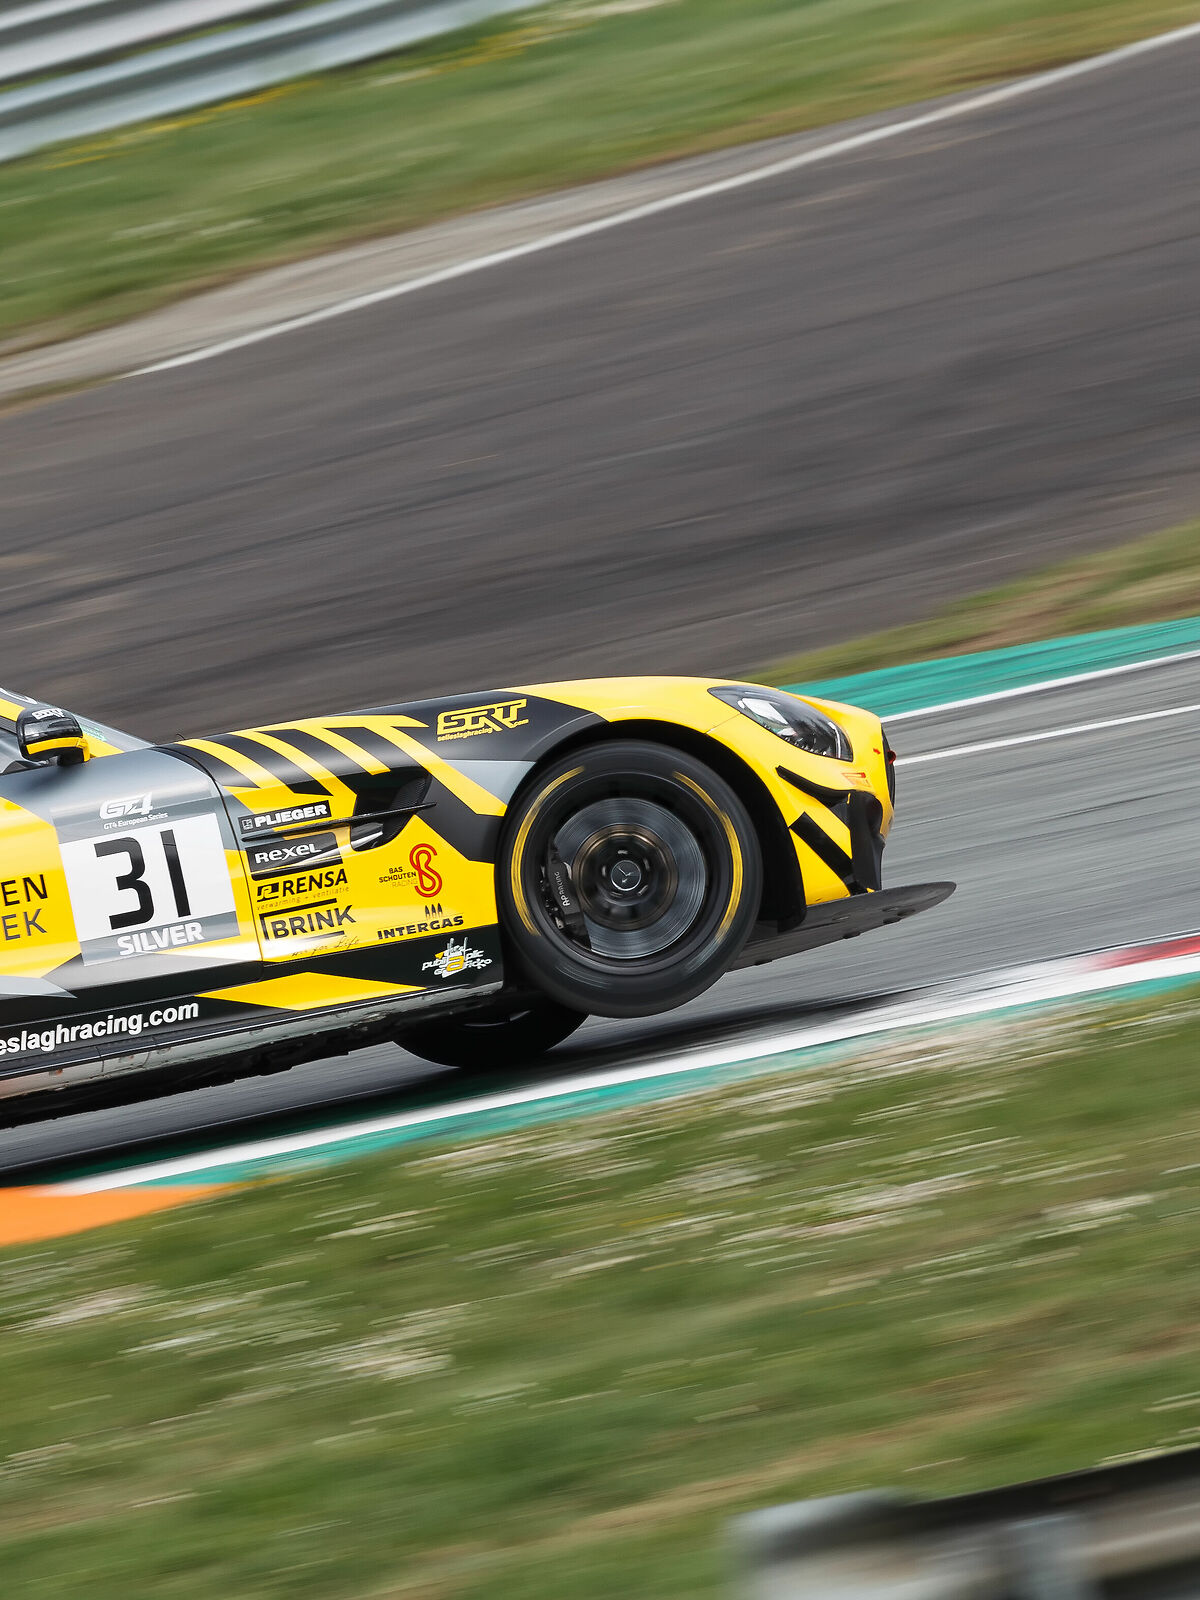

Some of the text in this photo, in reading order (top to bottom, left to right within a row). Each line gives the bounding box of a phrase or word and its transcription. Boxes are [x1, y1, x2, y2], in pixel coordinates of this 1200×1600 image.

[437, 698, 527, 732] SRT
[99, 792, 153, 819] GT4
[254, 804, 328, 827] PLIEGER
[118, 816, 148, 828] European
[148, 812, 169, 821] Series
[94, 829, 192, 930] 31
[282, 868, 348, 897] RENSA
[378, 871, 417, 883] SCHOUTEN
[388, 866, 403, 874] BAS
[312, 886, 350, 899] ventilatie
[271, 904, 357, 939] BRINK
[377, 915, 464, 940] INTERGAS
[116, 921, 205, 956] SILVER
